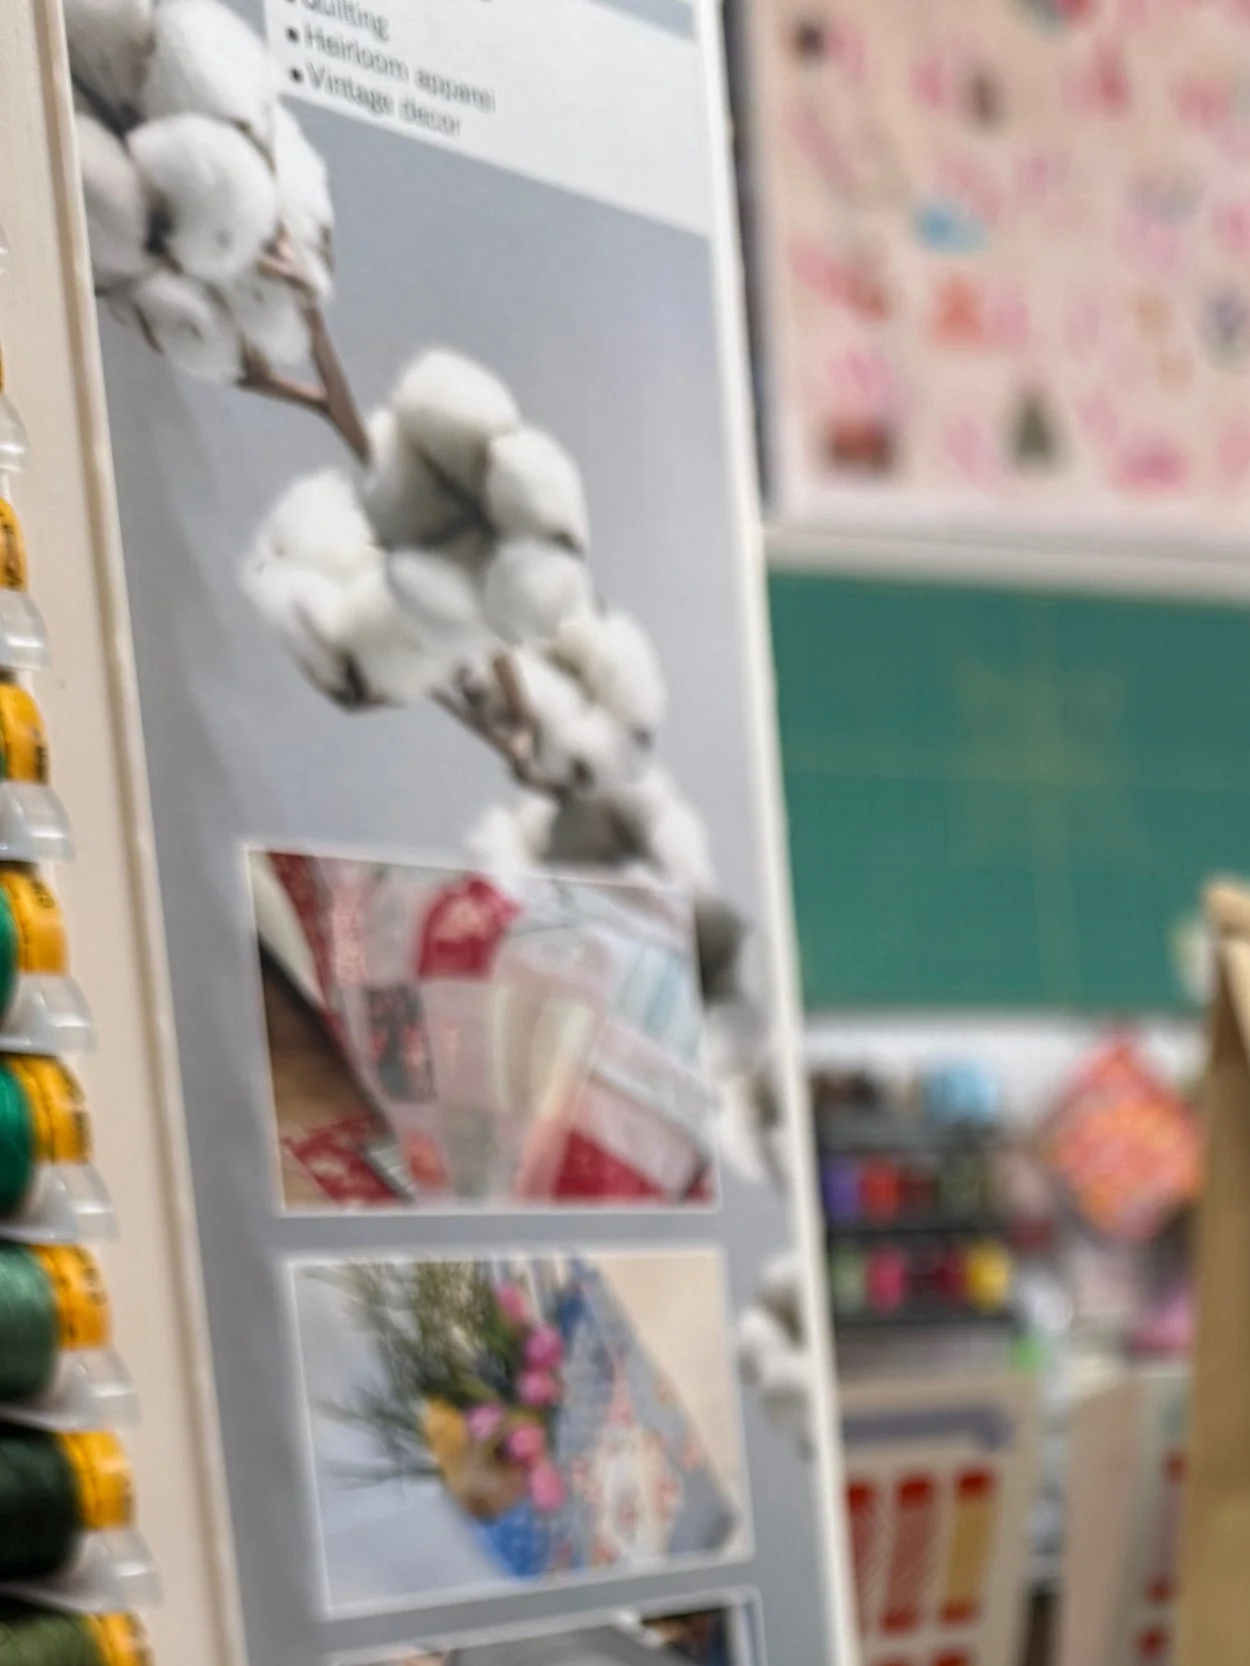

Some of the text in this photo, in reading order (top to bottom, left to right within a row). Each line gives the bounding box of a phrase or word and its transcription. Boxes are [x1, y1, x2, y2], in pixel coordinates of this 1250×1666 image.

[303, 21, 496, 113] Heirloom apparel
[305, 61, 462, 136] Vintage decor
